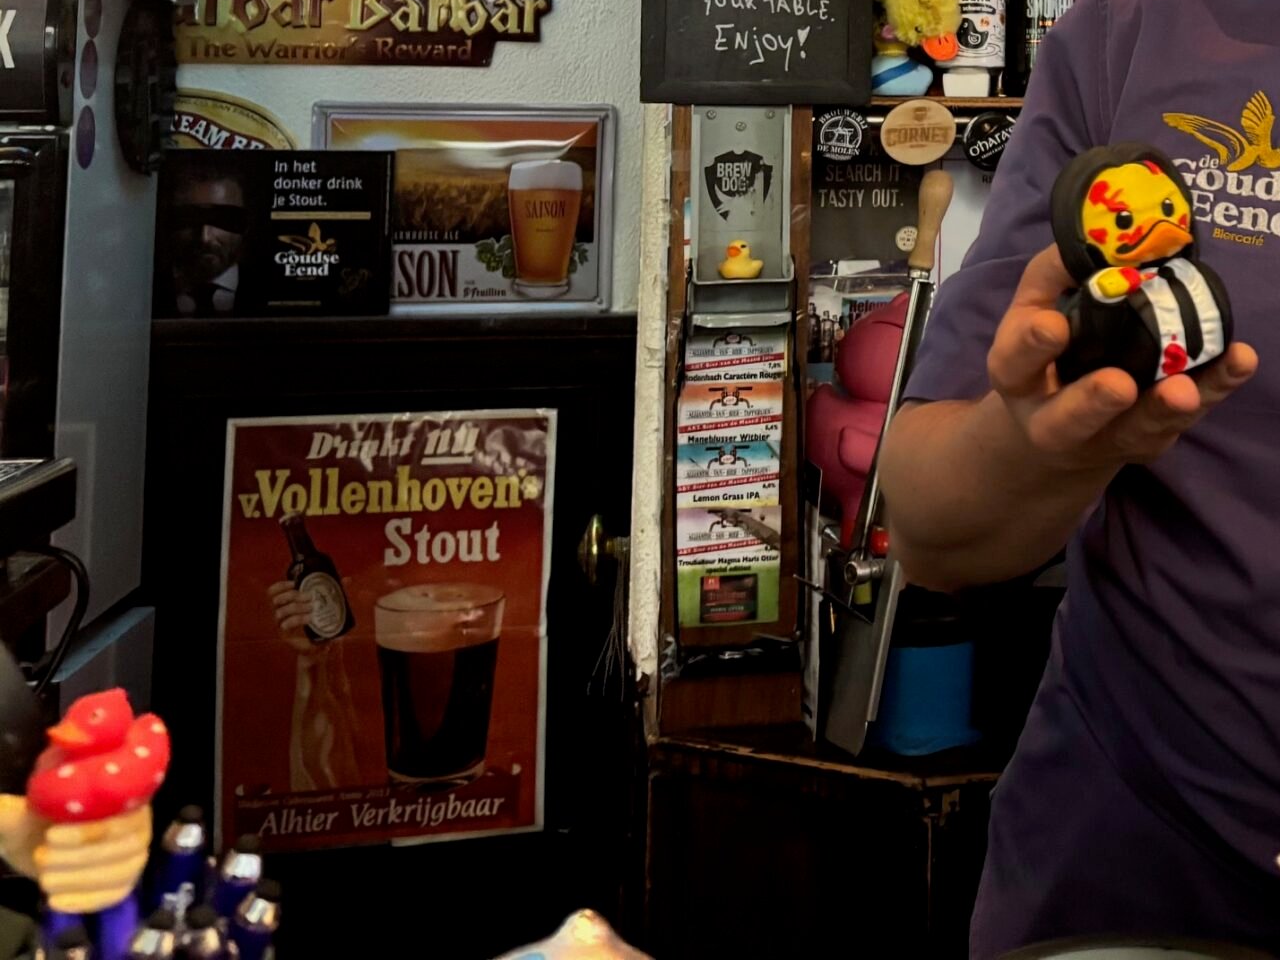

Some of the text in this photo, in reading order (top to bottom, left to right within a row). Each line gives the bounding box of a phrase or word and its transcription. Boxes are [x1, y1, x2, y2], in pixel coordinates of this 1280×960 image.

[189, 36, 473, 61] The Warrior's Reward
[817, 144, 861, 156] DE MOLEN
[275, 160, 316, 173] In het
[1200, 154, 1219, 168] de
[717, 162, 751, 177] BREW
[826, 164, 881, 182] SEARCH
[274, 176, 363, 190] donker drink
[272, 192, 328, 207] je Stout.
[819, 188, 904, 208] TASTY OUT.
[525, 199, 565, 218] SAISON
[1213, 227, 1265, 247] Biercafé
[274, 250, 340, 265] Goudse
[284, 263, 329, 277] Eend
[693, 494, 720, 503] Lemon
[722, 492, 744, 501] Grass
[383, 517, 501, 567] Stout
[258, 807, 338, 837] Alhier
[350, 794, 505, 830] Verkrijgbaar
